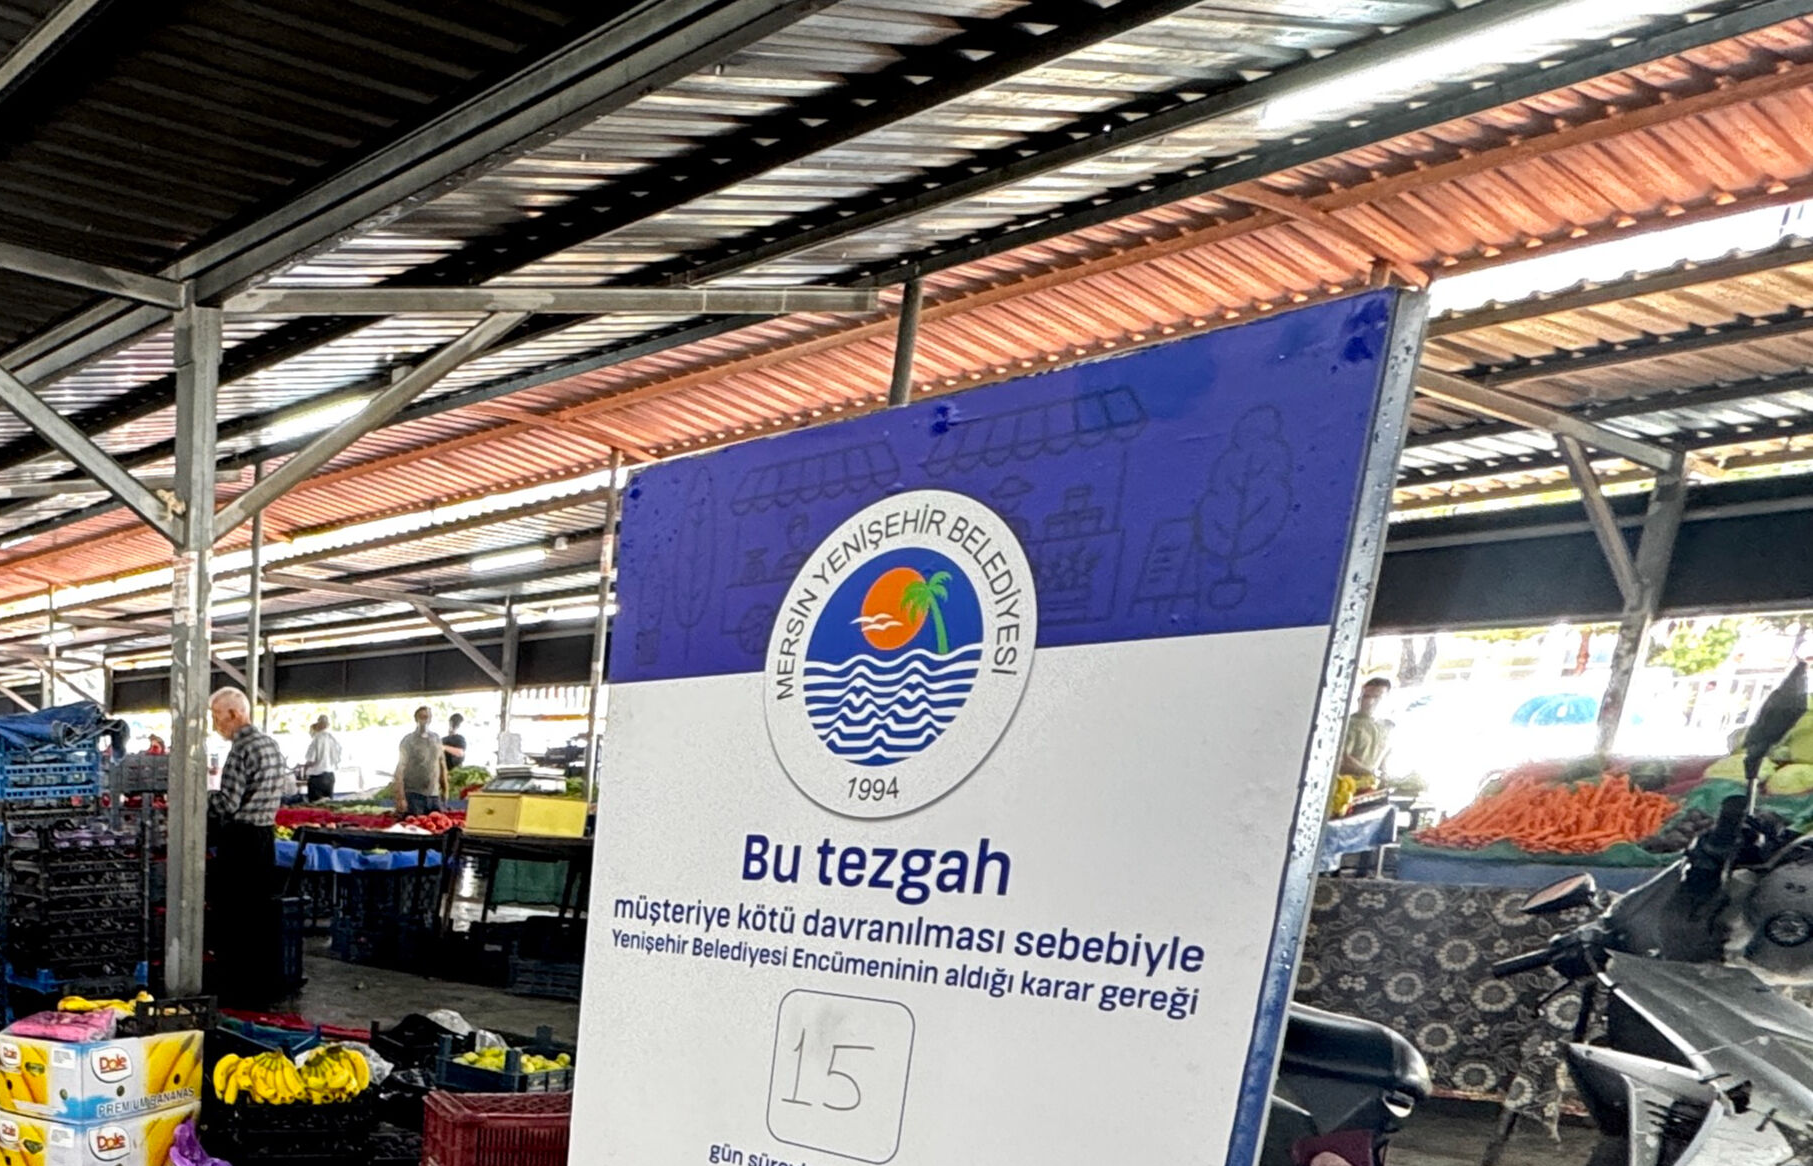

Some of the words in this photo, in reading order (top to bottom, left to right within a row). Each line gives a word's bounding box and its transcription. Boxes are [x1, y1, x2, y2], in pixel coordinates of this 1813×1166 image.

[812, 503, 946, 584] YENİŞEHİR
[847, 776, 900, 801] 1994
[742, 834, 802, 884] Bu
[817, 837, 1011, 905] tezgah
[613, 895, 731, 933] müşteriye
[737, 902, 796, 934] kötü
[802, 908, 1005, 954] davranılması
[1014, 927, 1205, 977] sebebiyle
[612, 928, 689, 955] Yenişehir
[692, 937, 788, 968] Belediyesi
[792, 947, 938, 984] Encümeninin
[945, 963, 1014, 998] aldığı
[1020, 970, 1095, 1003] karar
[1098, 984, 1199, 1020] gereği
[99, 1053, 127, 1071] Dole
[781, 1028, 876, 1111] 15
[97, 1096, 148, 1117] PREMIUM
[150, 1086, 195, 1107] BANANAS
[96, 1132, 125, 1149] Dole
[708, 1143, 744, 1166] gün
